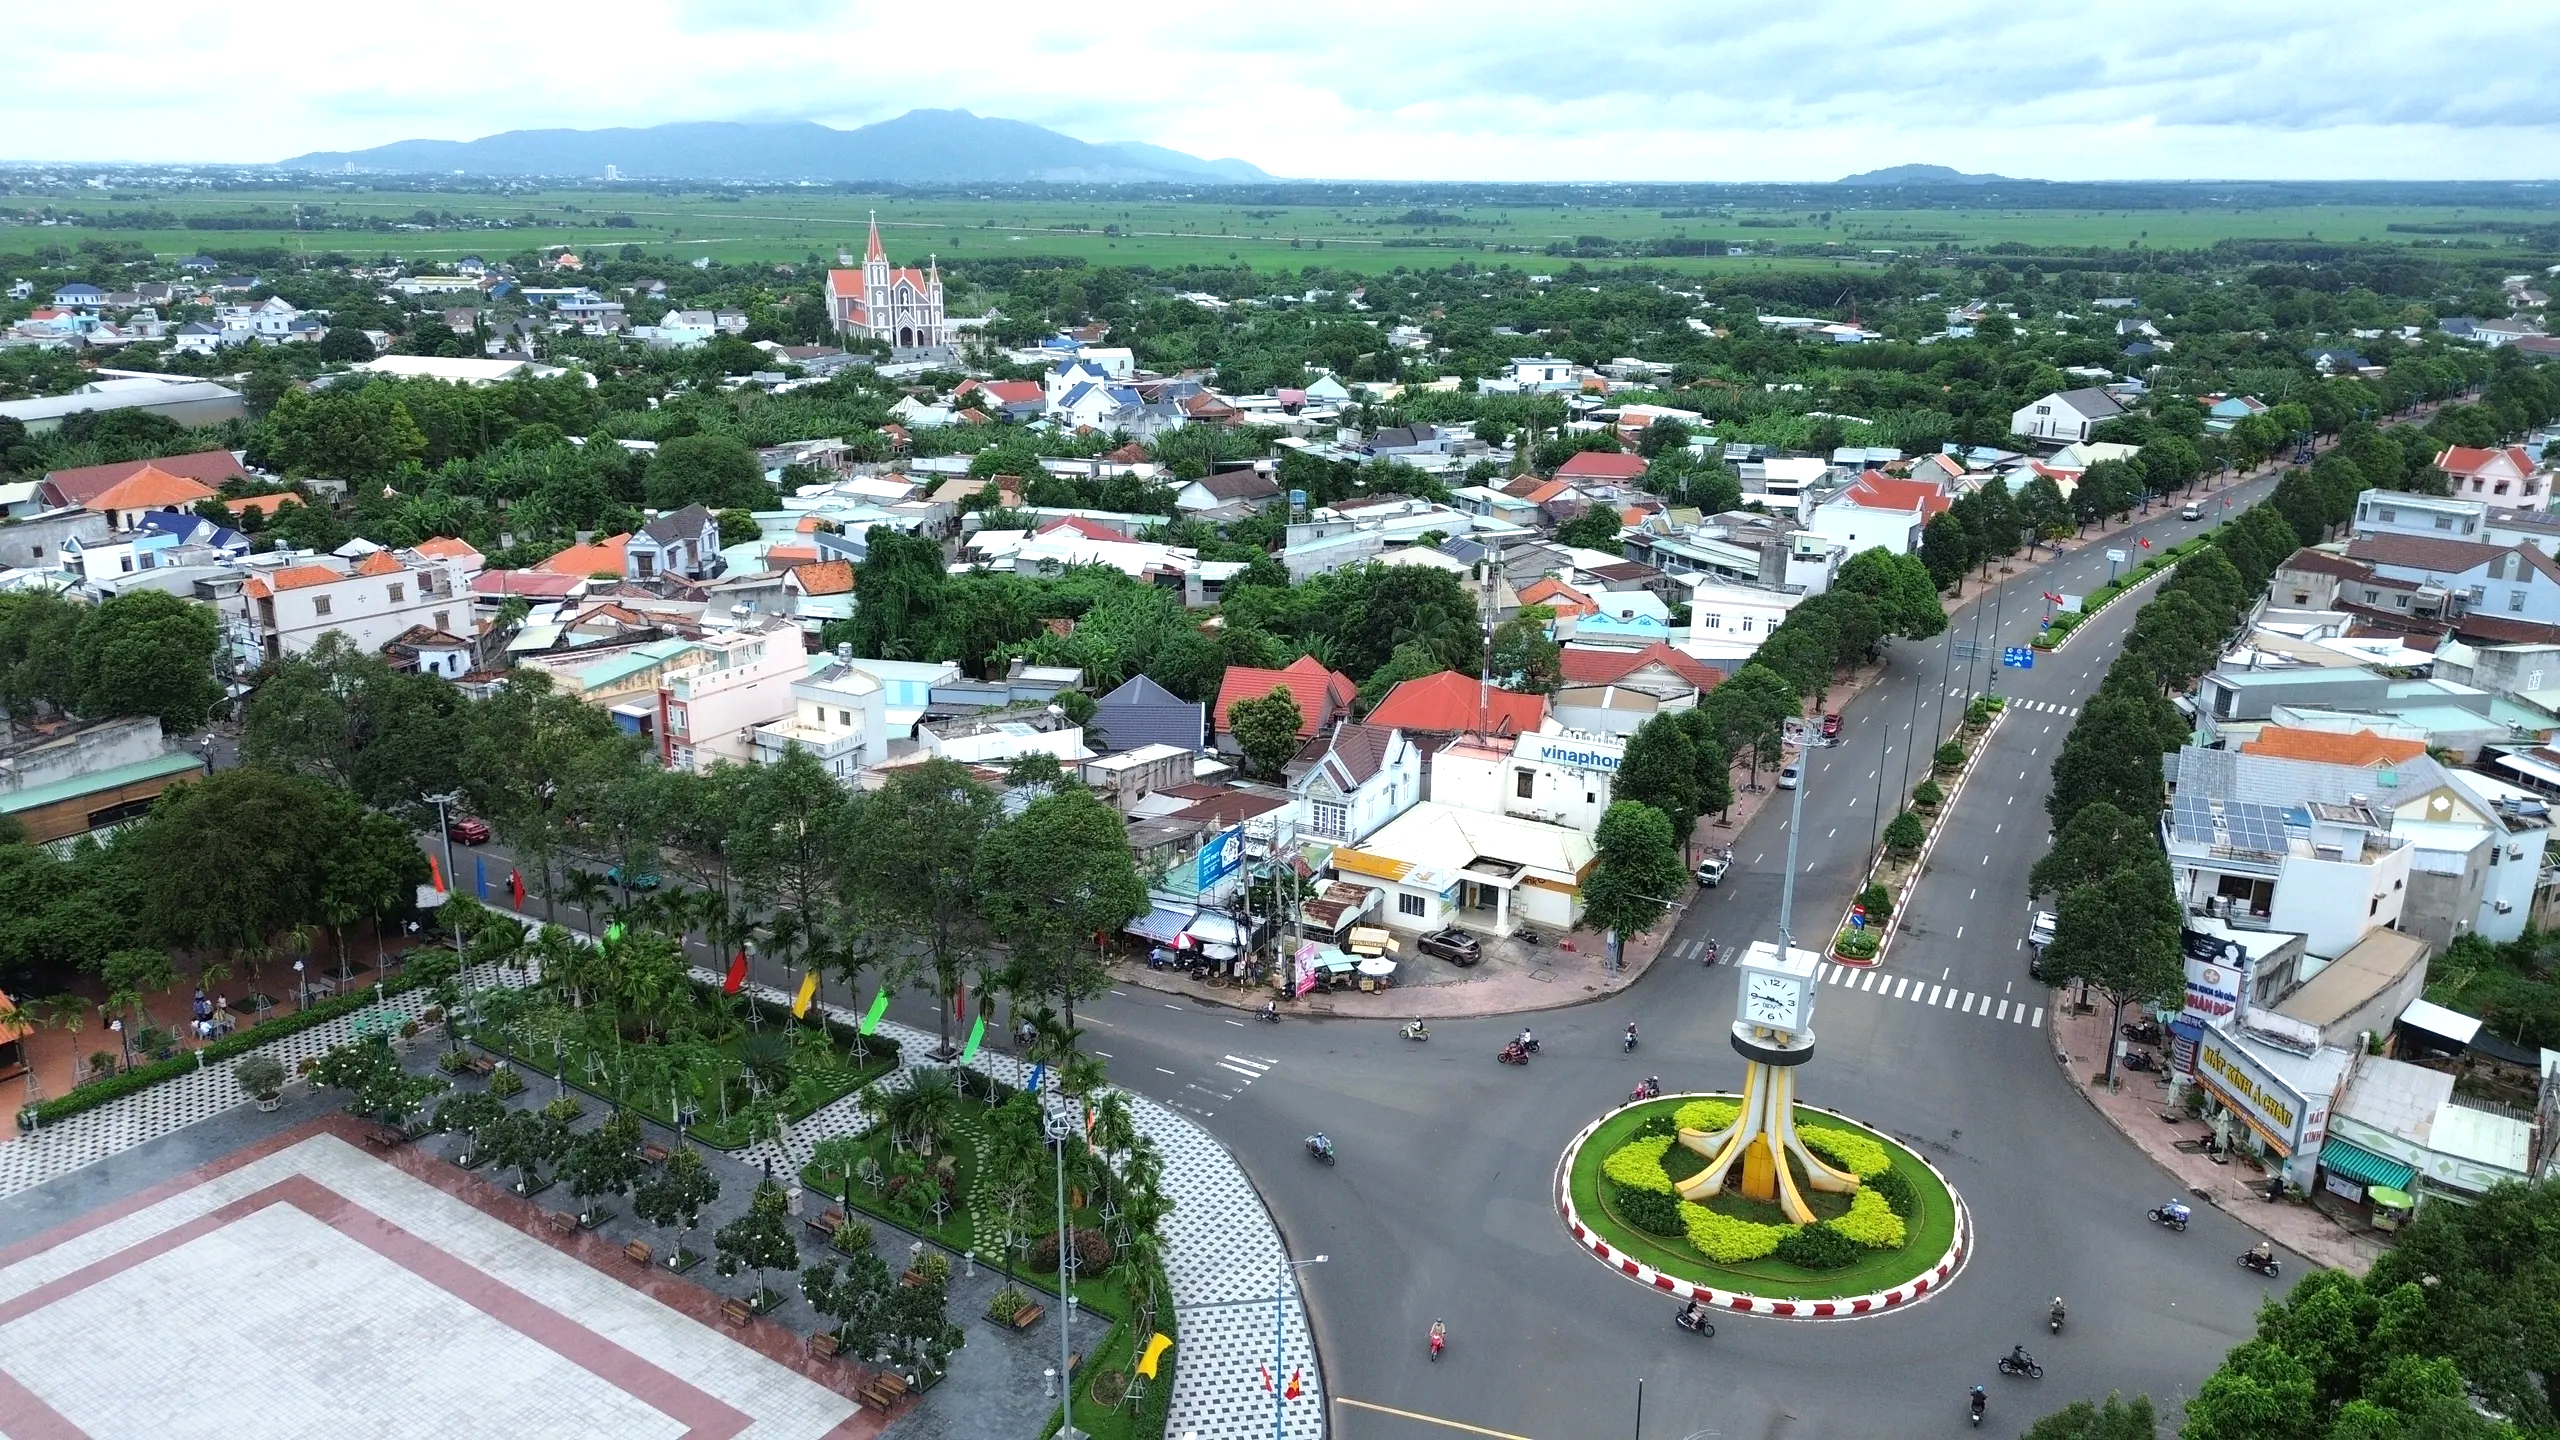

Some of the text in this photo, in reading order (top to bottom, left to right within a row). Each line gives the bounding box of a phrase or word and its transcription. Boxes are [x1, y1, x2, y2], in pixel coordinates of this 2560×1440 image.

[1541, 745, 1622, 769] vinaphon
[2225, 1062, 2253, 1098] KÍNH
[2303, 1128, 2322, 1144] KÍNH
